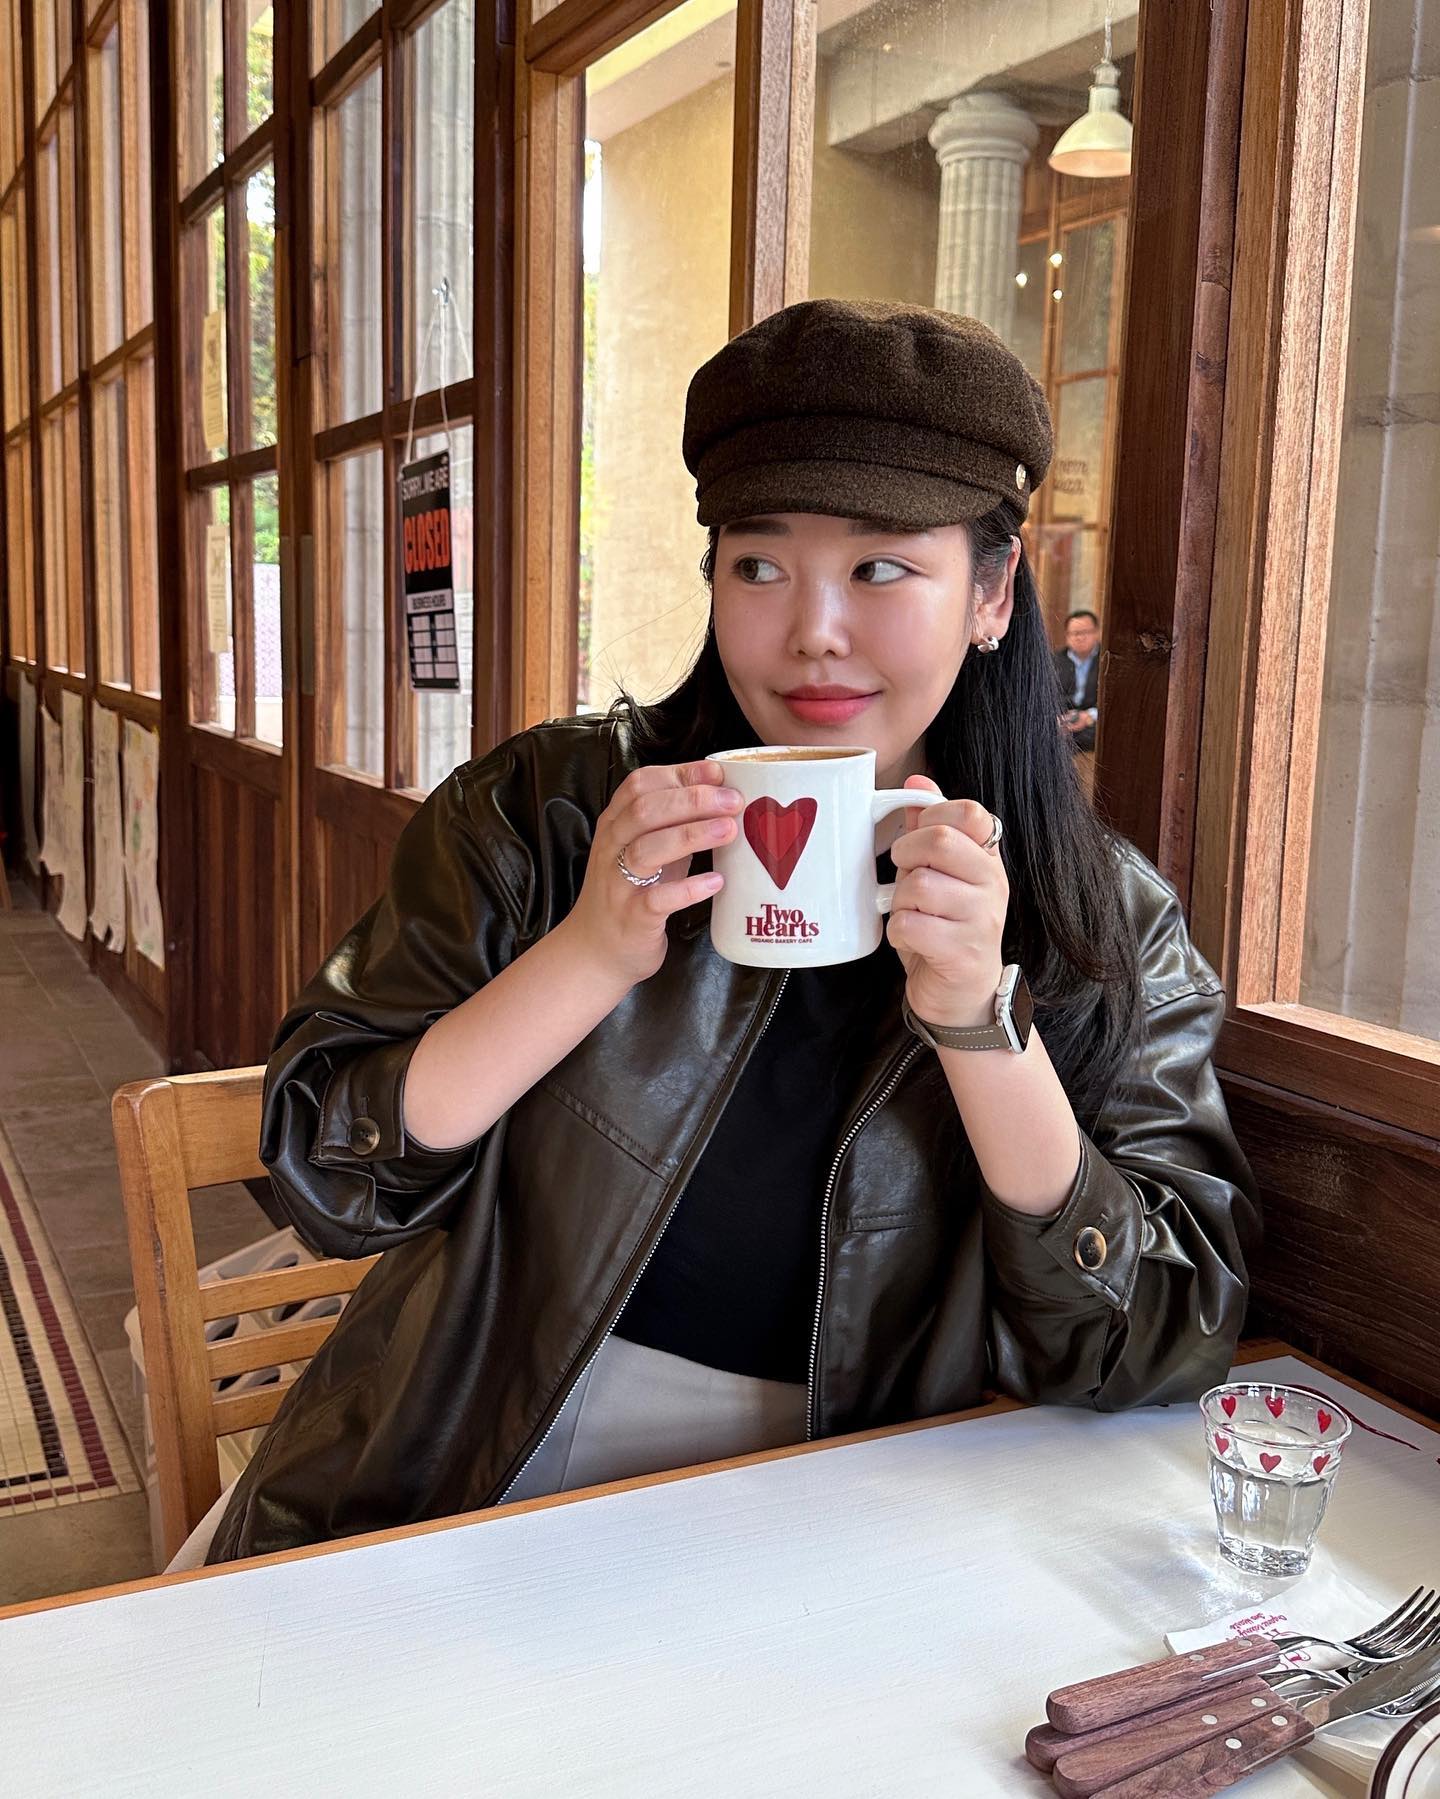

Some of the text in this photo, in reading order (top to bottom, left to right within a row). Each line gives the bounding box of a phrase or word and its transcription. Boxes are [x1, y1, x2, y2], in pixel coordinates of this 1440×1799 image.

[404, 508, 450, 574] CLOSED
[760, 904, 804, 924] Two
[745, 916, 820, 938] Hearts
